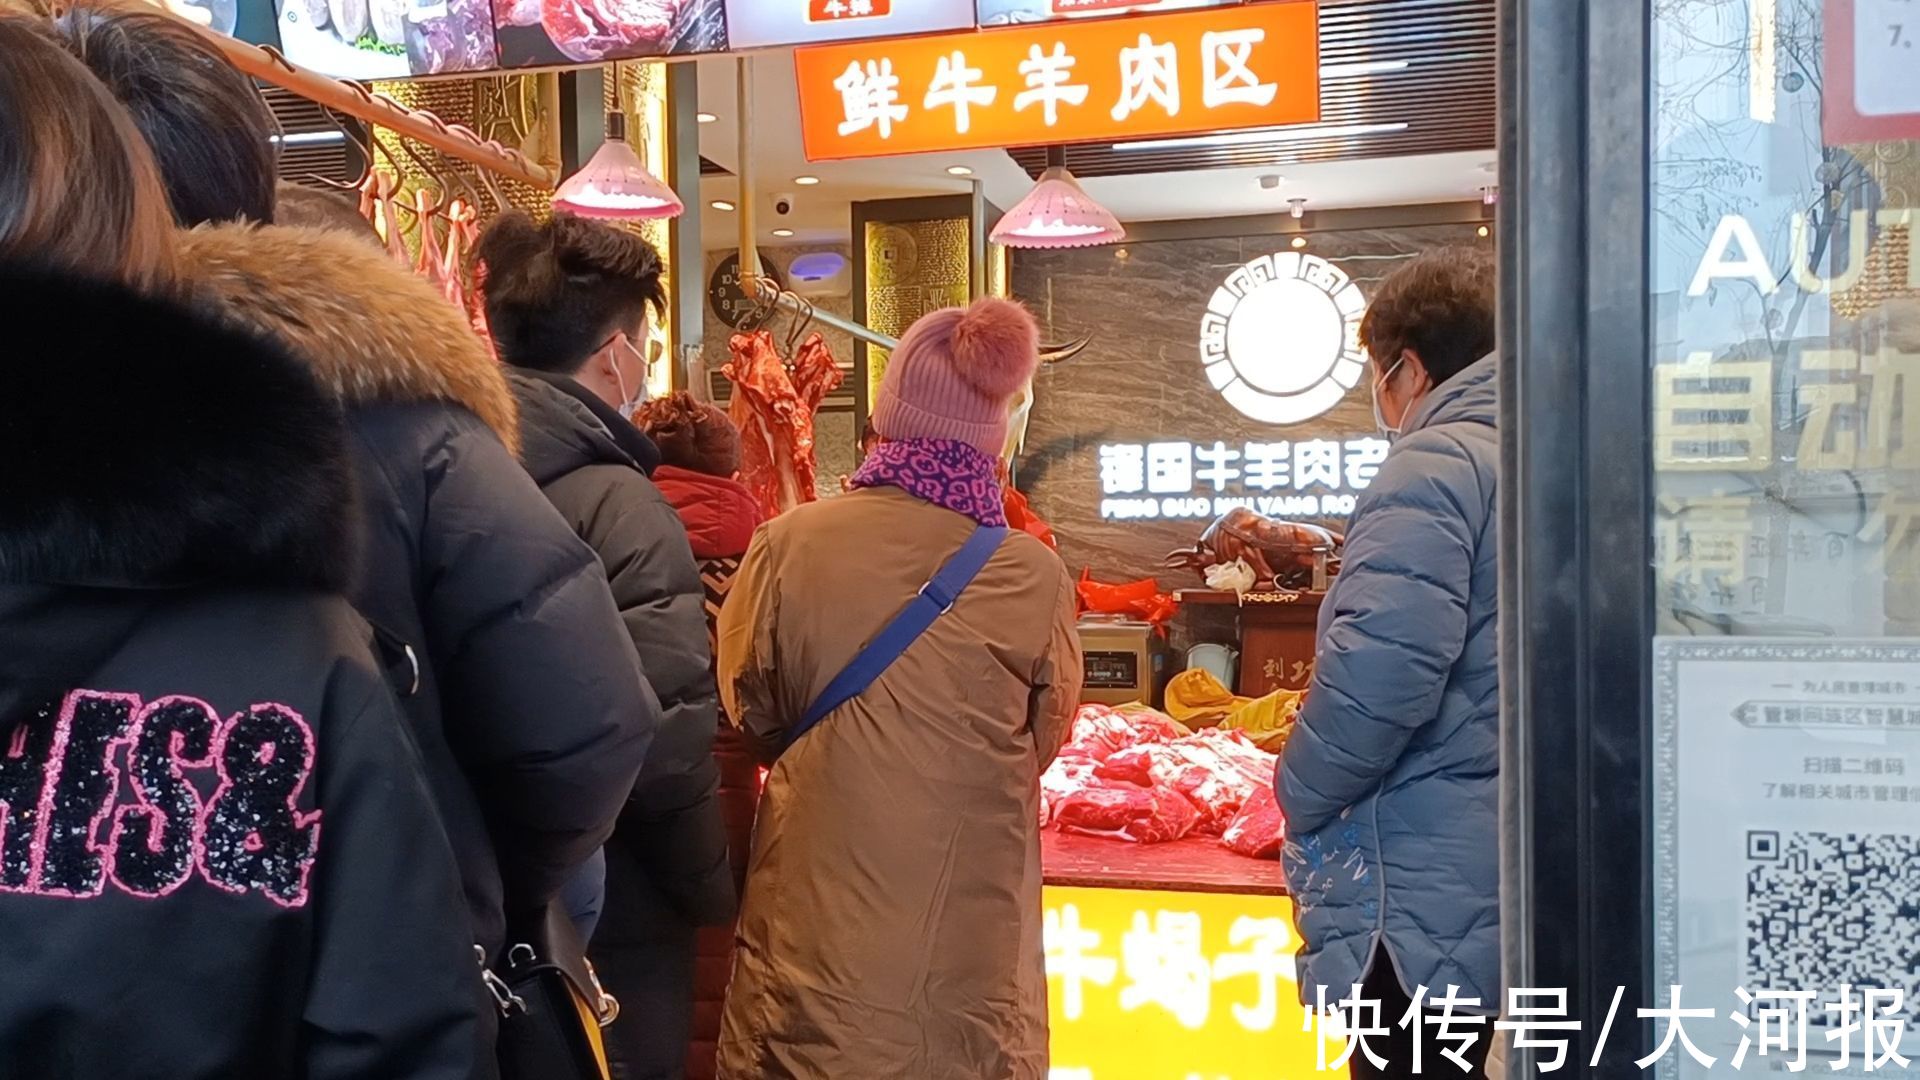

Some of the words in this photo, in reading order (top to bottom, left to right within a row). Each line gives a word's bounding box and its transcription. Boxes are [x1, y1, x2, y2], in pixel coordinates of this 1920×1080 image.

[833, 28, 1278, 139] 鲜牛羊肉区
[718, 287, 726, 298] 9
[722, 299, 730, 311] 8
[1653, 348, 1920, 471] 自动
[1161, 497, 1211, 518] GUO
[1803, 757, 1905, 776] 扫描二维码
